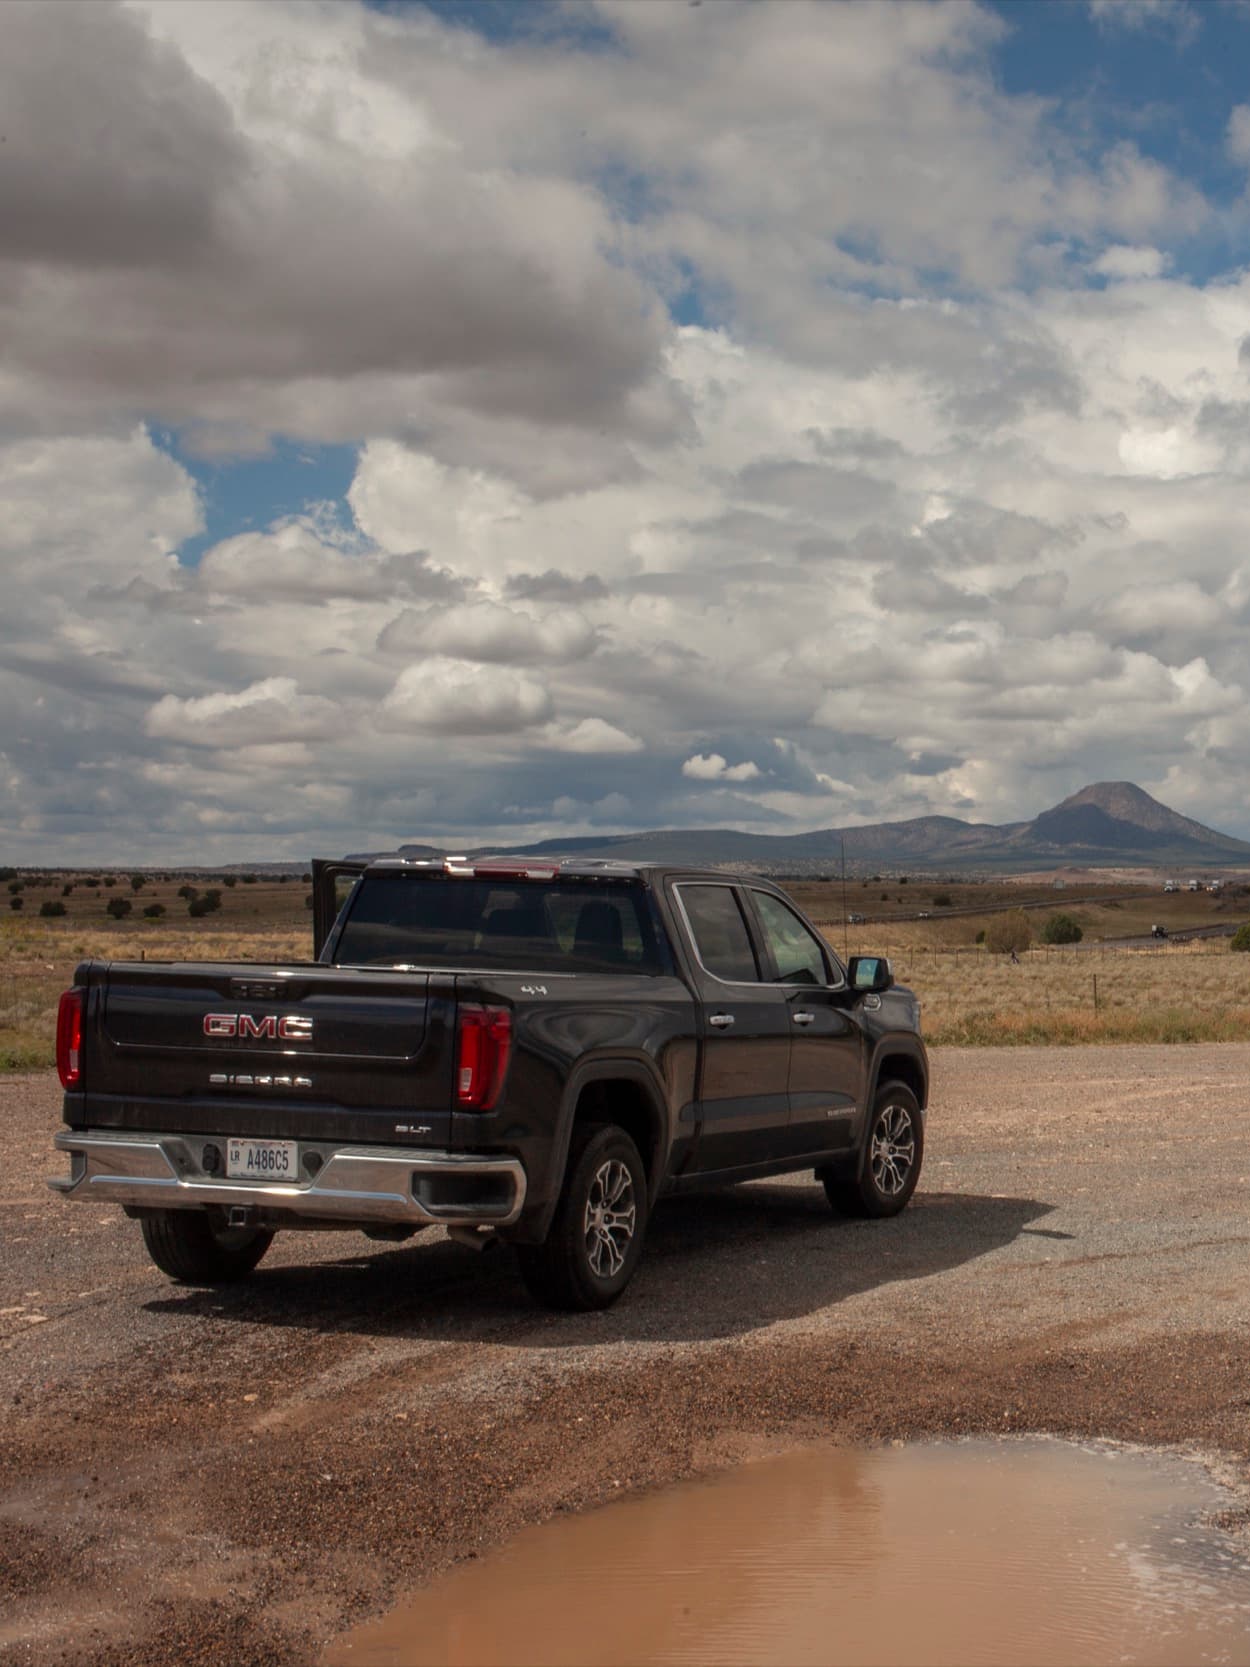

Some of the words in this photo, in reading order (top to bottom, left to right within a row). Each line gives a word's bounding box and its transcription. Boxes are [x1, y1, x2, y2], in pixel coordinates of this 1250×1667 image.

[203, 1013, 313, 1040] GMC
[209, 1074, 313, 1088] SIERRA
[247, 1149, 289, 1170] A486C5
